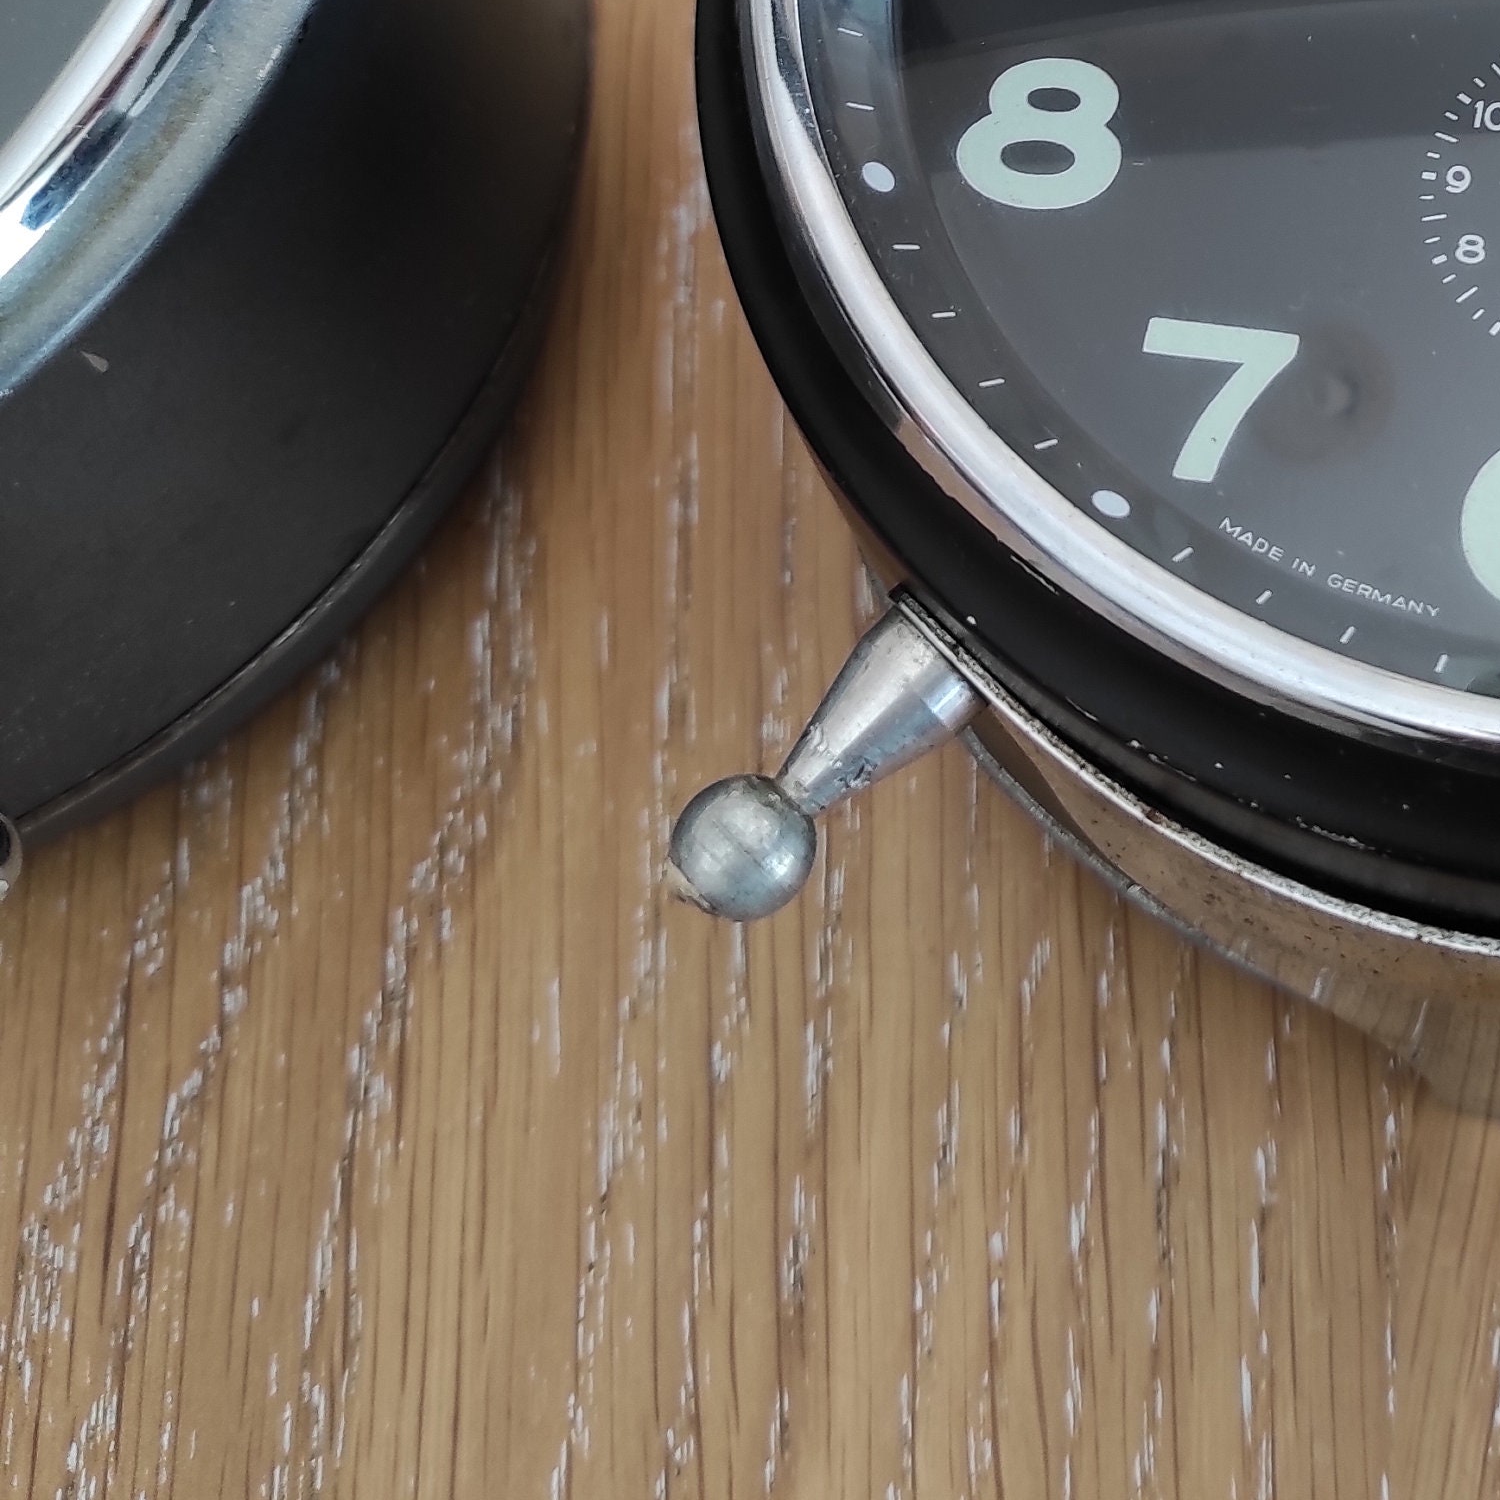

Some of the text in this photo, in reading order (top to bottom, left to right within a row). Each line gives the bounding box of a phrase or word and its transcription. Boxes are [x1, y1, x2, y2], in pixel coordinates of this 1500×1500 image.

[956, 57, 1122, 209] 8
[1445, 166, 1472, 193] 9
[1455, 235, 1486, 264] 8
[1142, 317, 1300, 483] 7
[1219, 517, 1440, 617] MADE IN GERMANY
